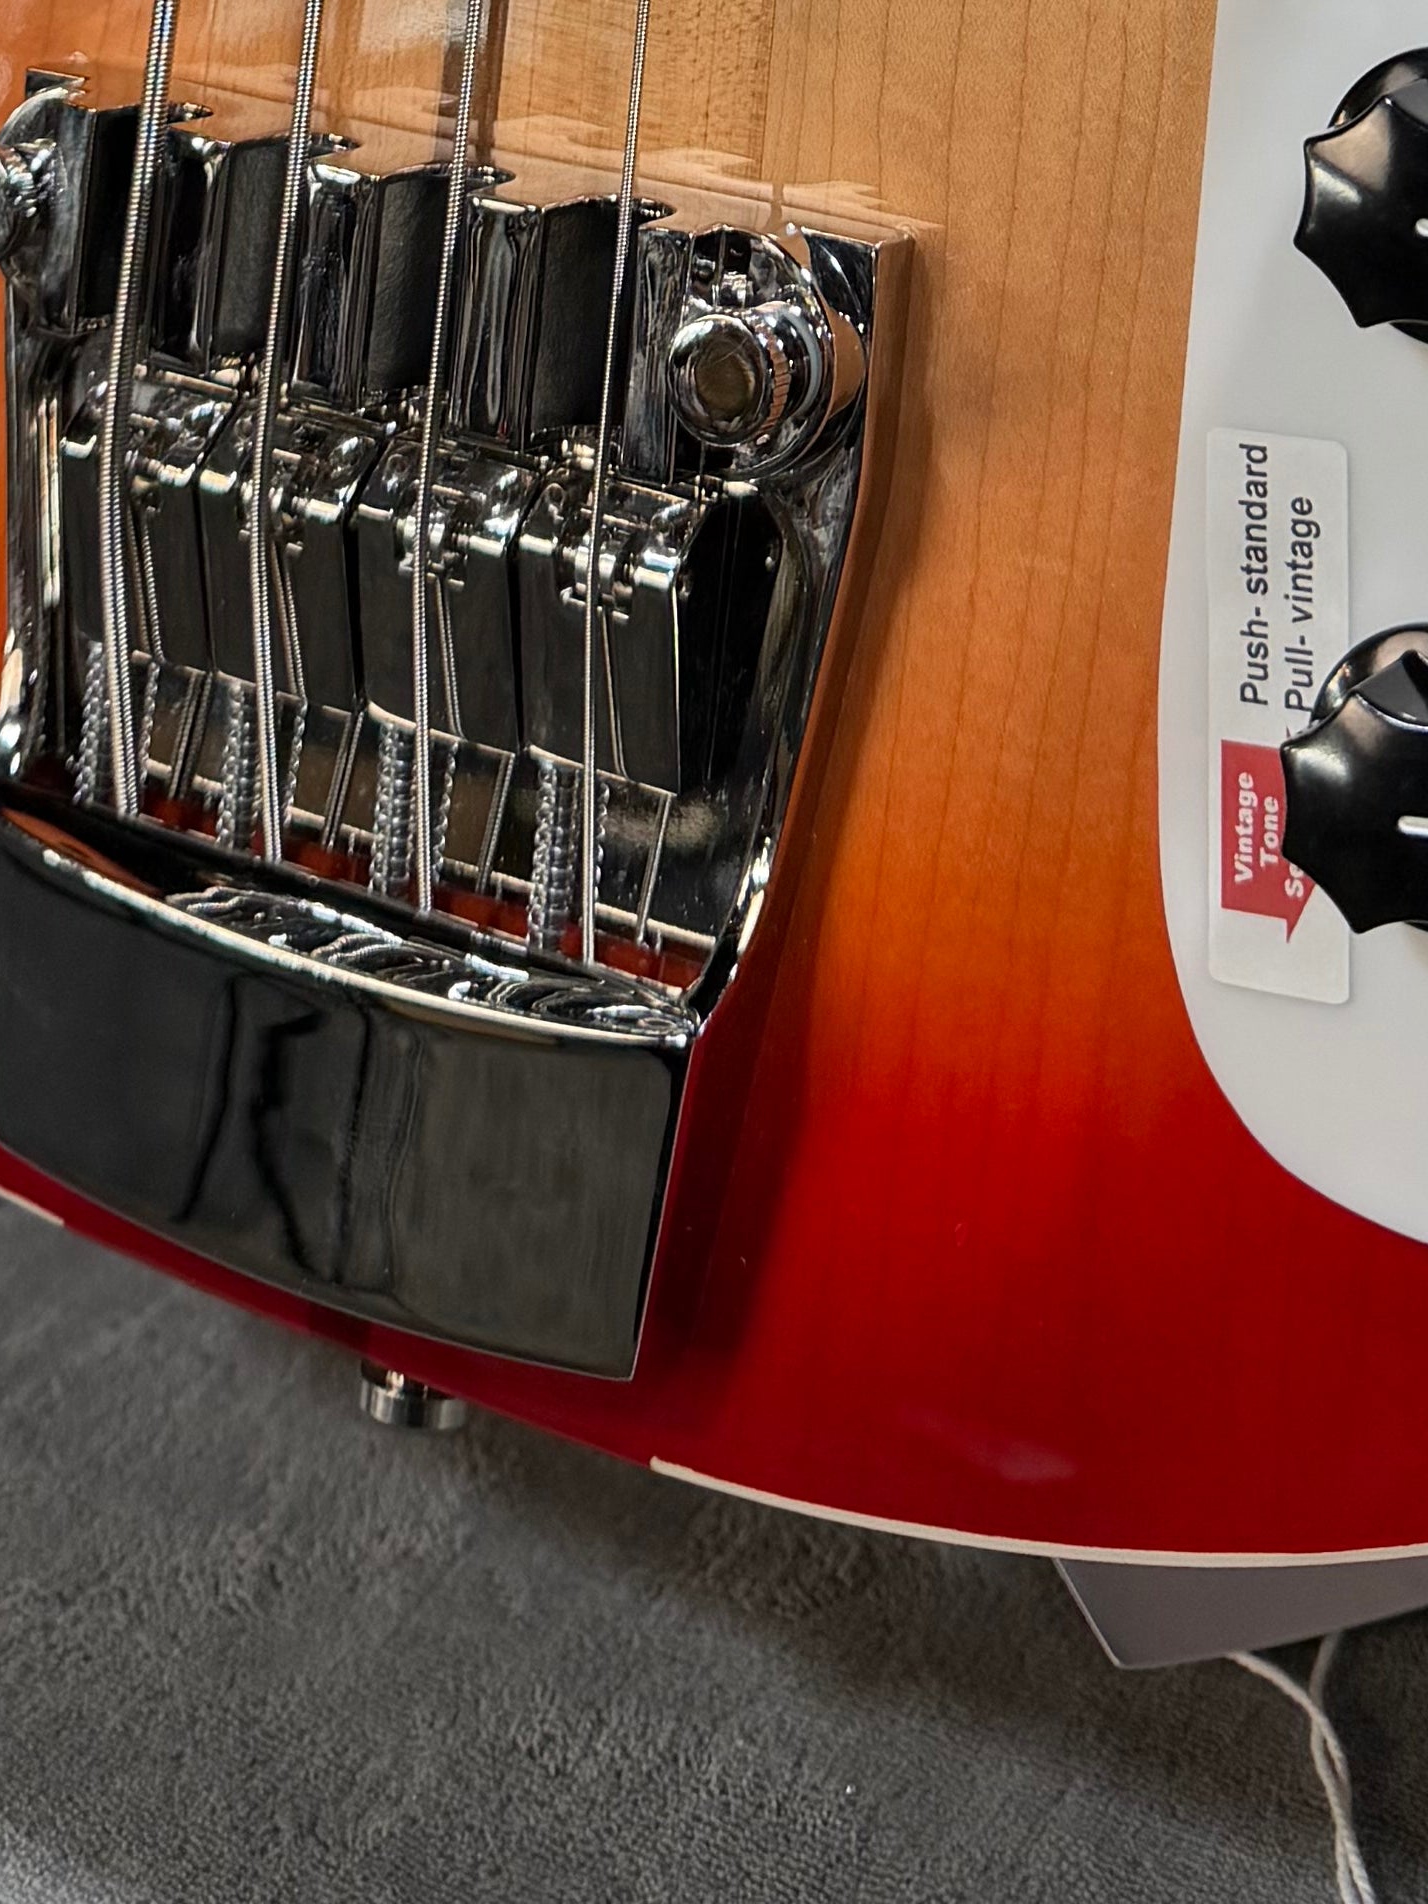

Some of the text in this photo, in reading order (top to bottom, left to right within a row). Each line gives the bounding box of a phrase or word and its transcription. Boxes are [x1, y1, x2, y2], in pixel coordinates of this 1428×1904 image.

[1238, 443, 1269, 705] Push- standard
[1283, 496, 1321, 712] Pull- vintage
[1234, 772, 1258, 883] Vintage
[1259, 796, 1279, 868] Tone
